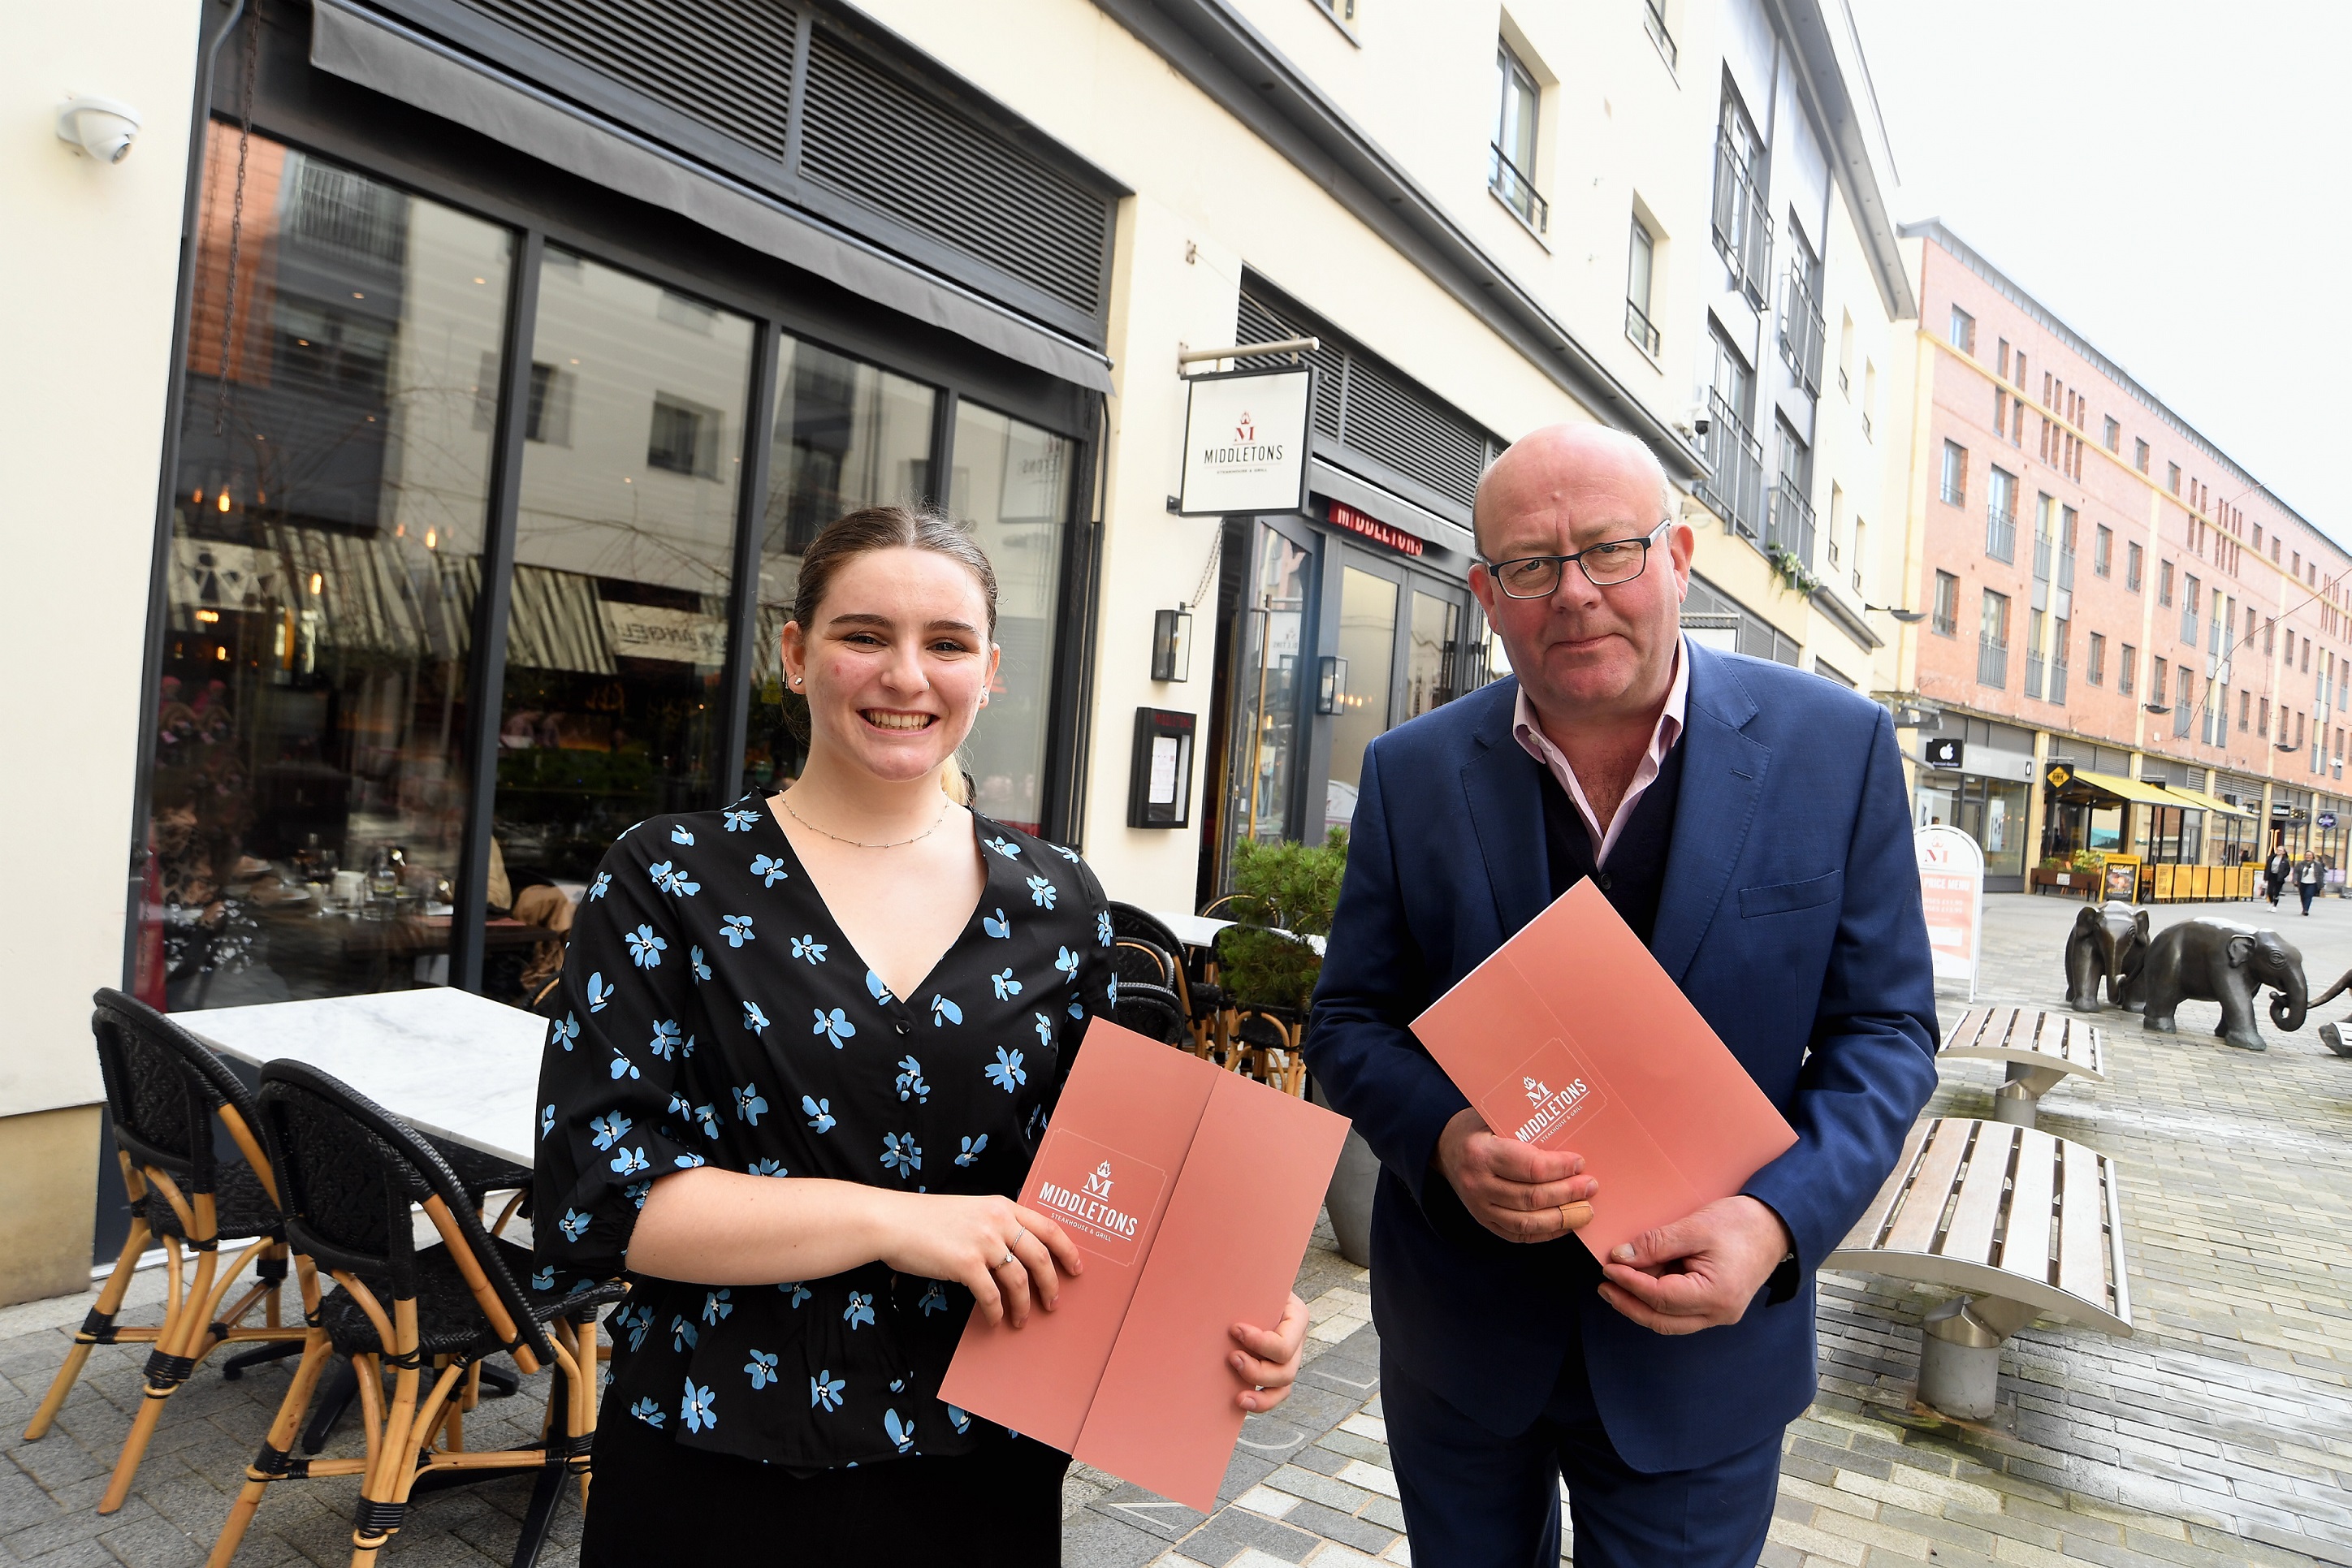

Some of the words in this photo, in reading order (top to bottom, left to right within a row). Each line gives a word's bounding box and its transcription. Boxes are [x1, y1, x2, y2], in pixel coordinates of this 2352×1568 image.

[1204, 444, 1283, 464] MIDDLETONS
[1948, 879, 1970, 892] MENU
[1514, 1078, 1588, 1143] MIDDLETONS
[1540, 1118, 1567, 1143] STEAKHOUSE
[1570, 1105, 1583, 1117] GRILL
[1038, 1181, 1139, 1236] MIDDLETONS
[1050, 1212, 1088, 1233] STEAKHOUSE
[1089, 1227, 1095, 1235] &
[1095, 1229, 1113, 1242] GRILL
